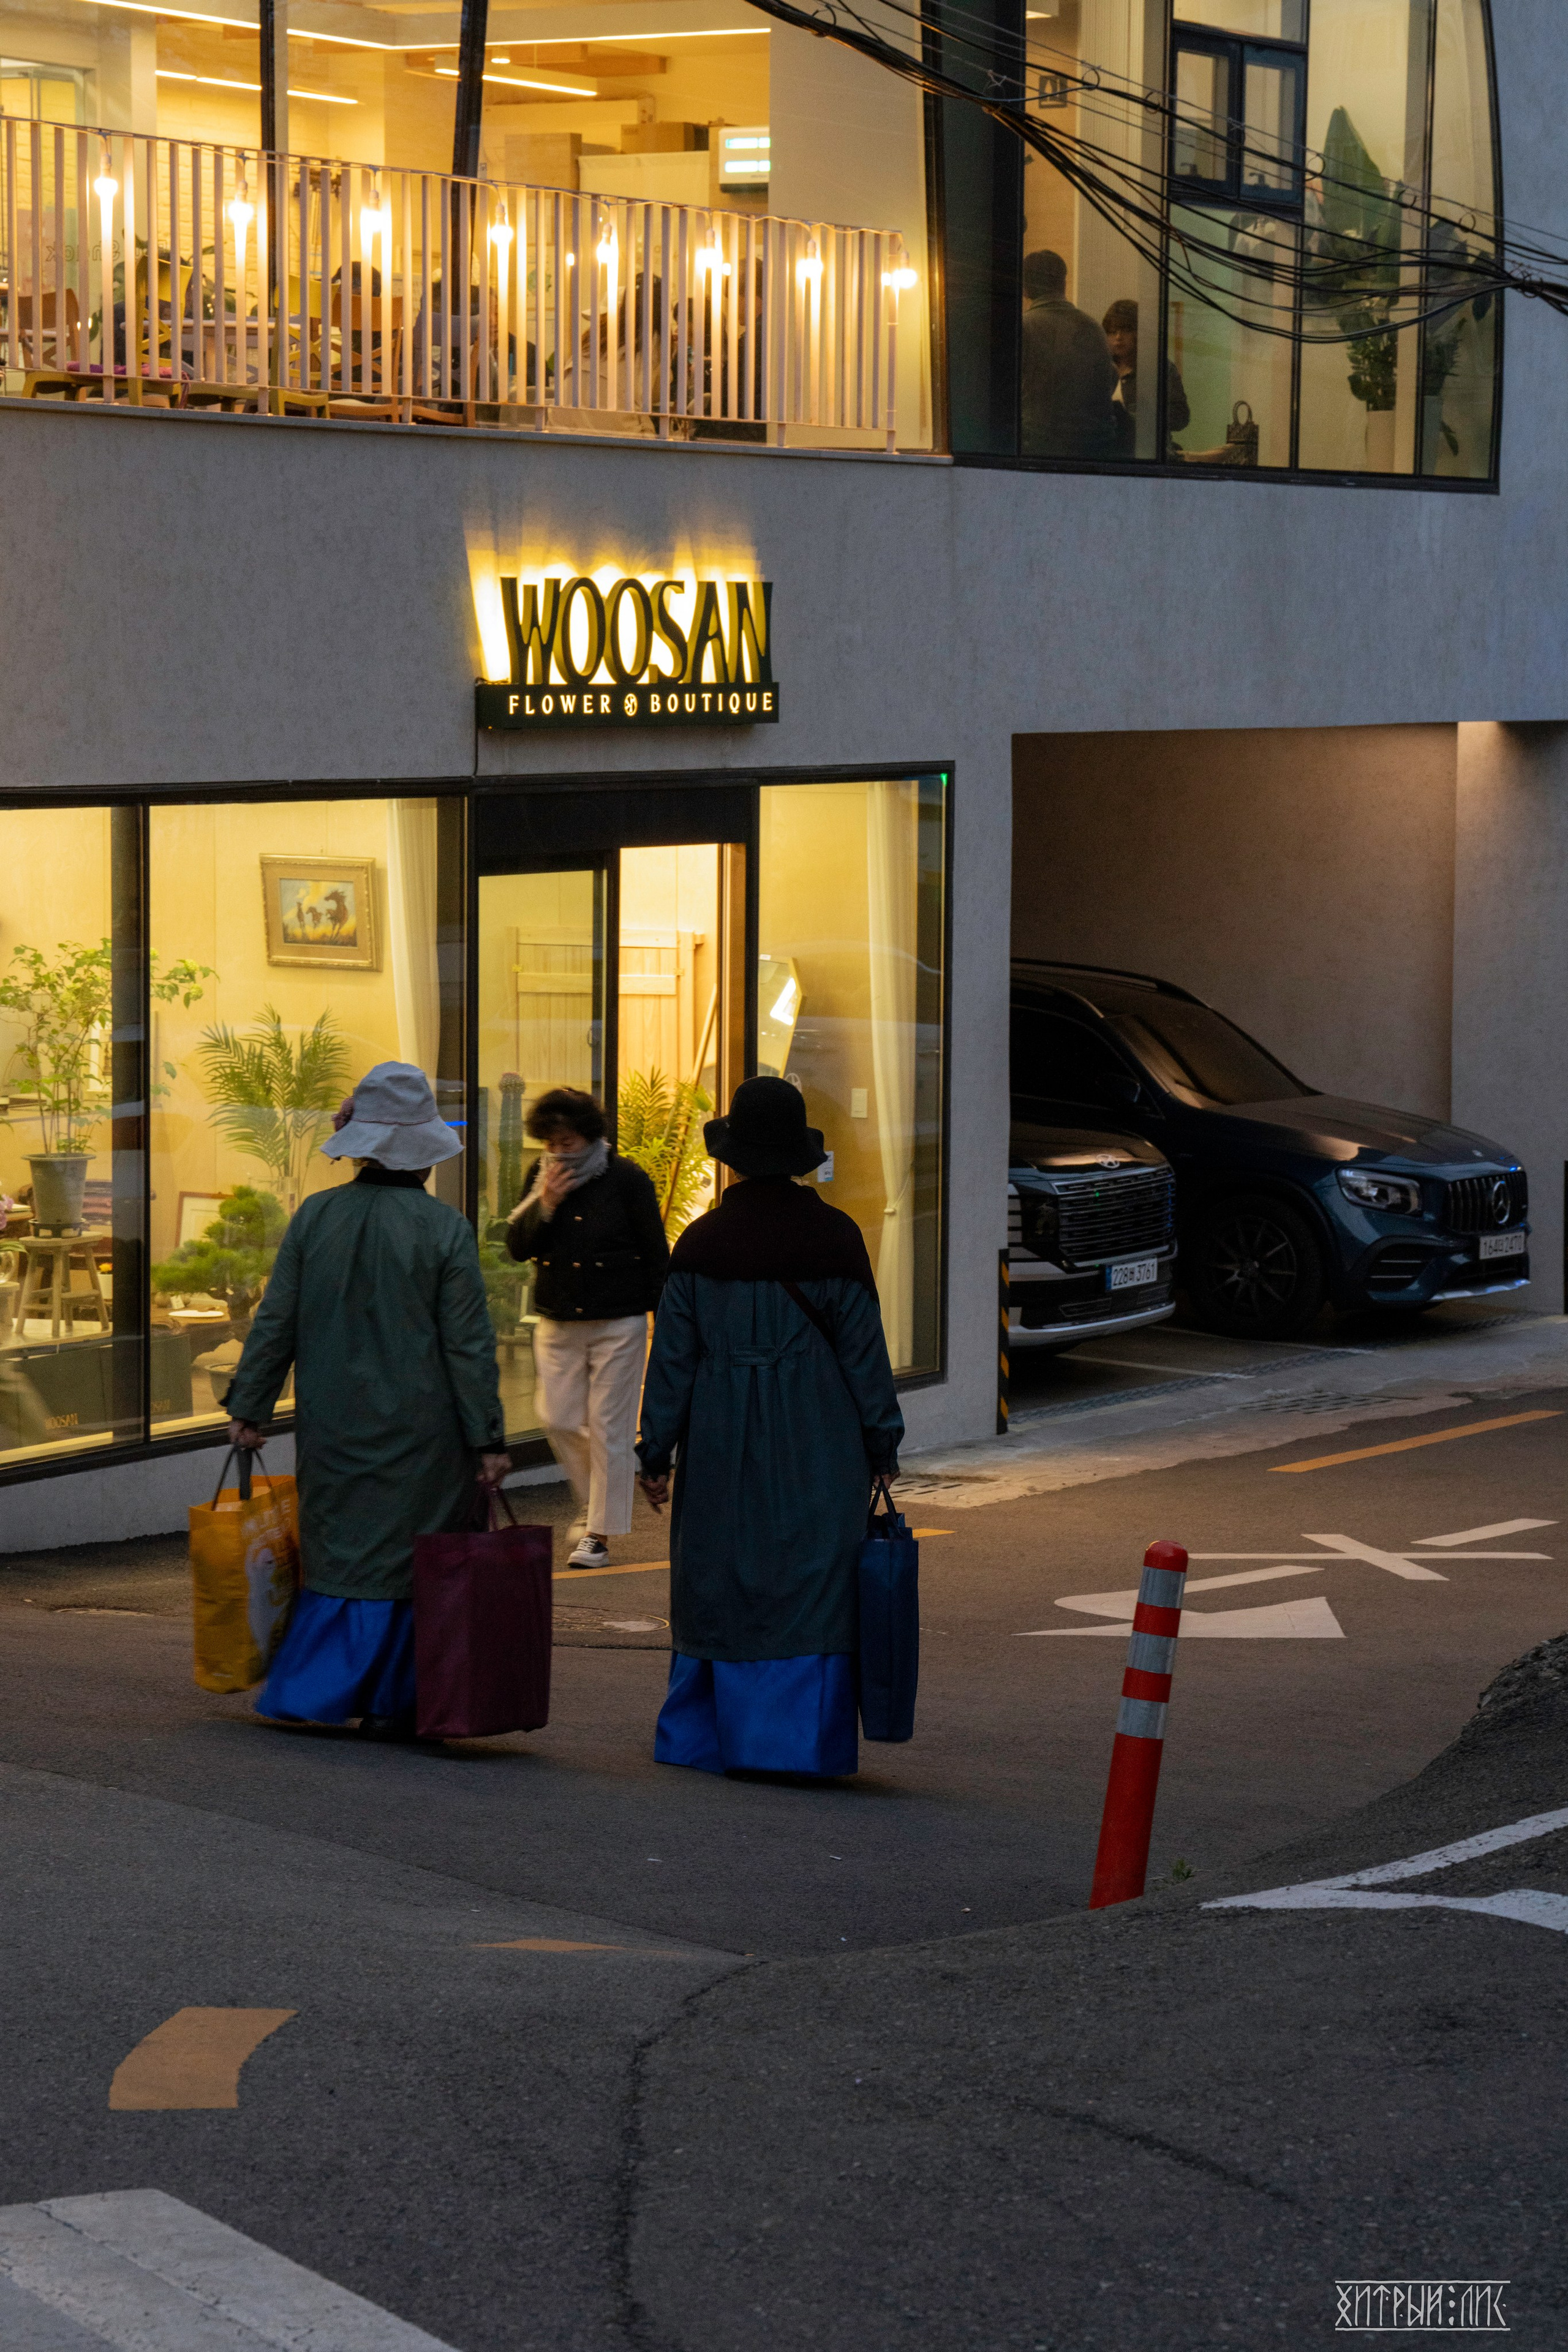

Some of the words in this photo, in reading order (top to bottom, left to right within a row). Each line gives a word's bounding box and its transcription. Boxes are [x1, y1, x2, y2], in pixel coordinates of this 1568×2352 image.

[500, 577, 773, 684] WOOSAN
[509, 694, 611, 715] FLOWER
[650, 692, 772, 714] BOUTIQUE
